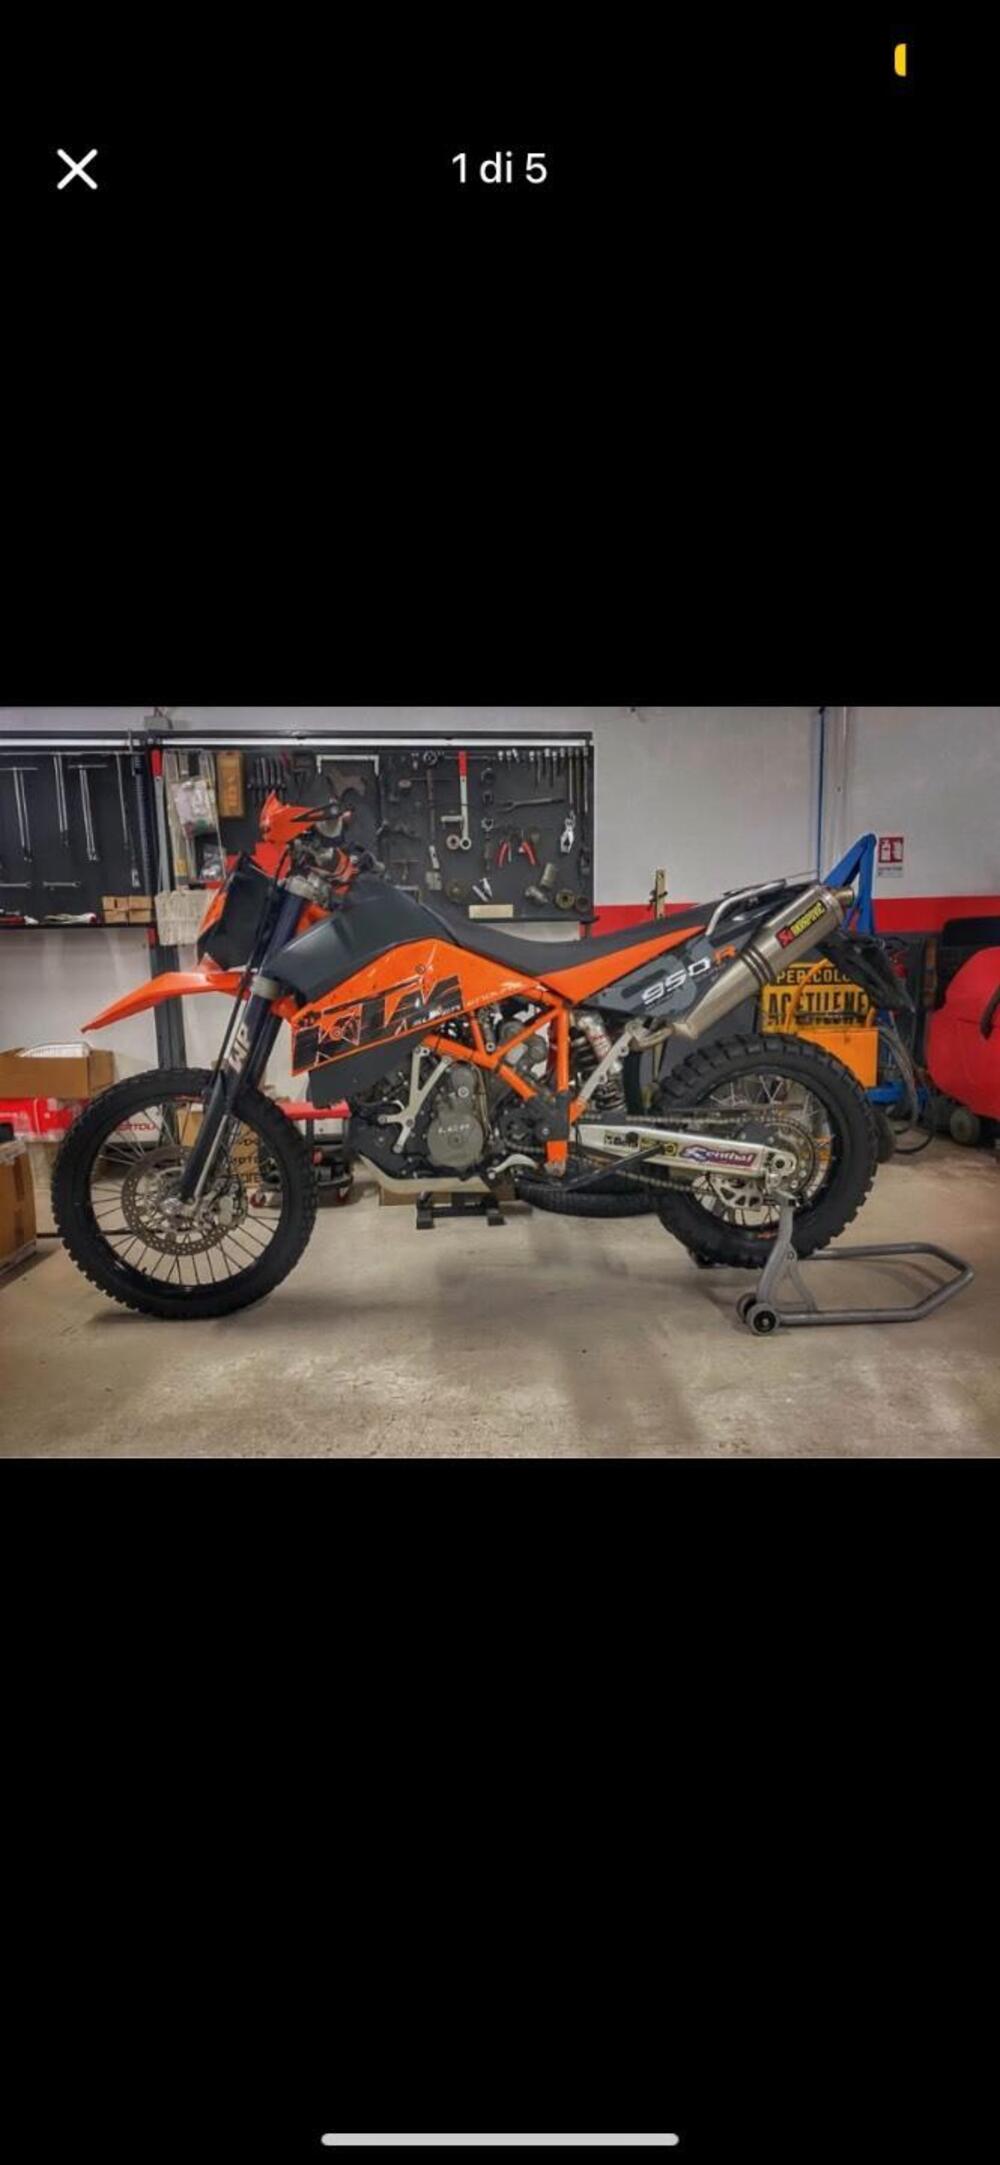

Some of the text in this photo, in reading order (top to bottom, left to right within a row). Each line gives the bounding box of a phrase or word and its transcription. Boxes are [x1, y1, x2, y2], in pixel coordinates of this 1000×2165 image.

[642, 956, 711, 1005] 950
[776, 968, 851, 984] PERCOL
[292, 973, 465, 1072] KTM
